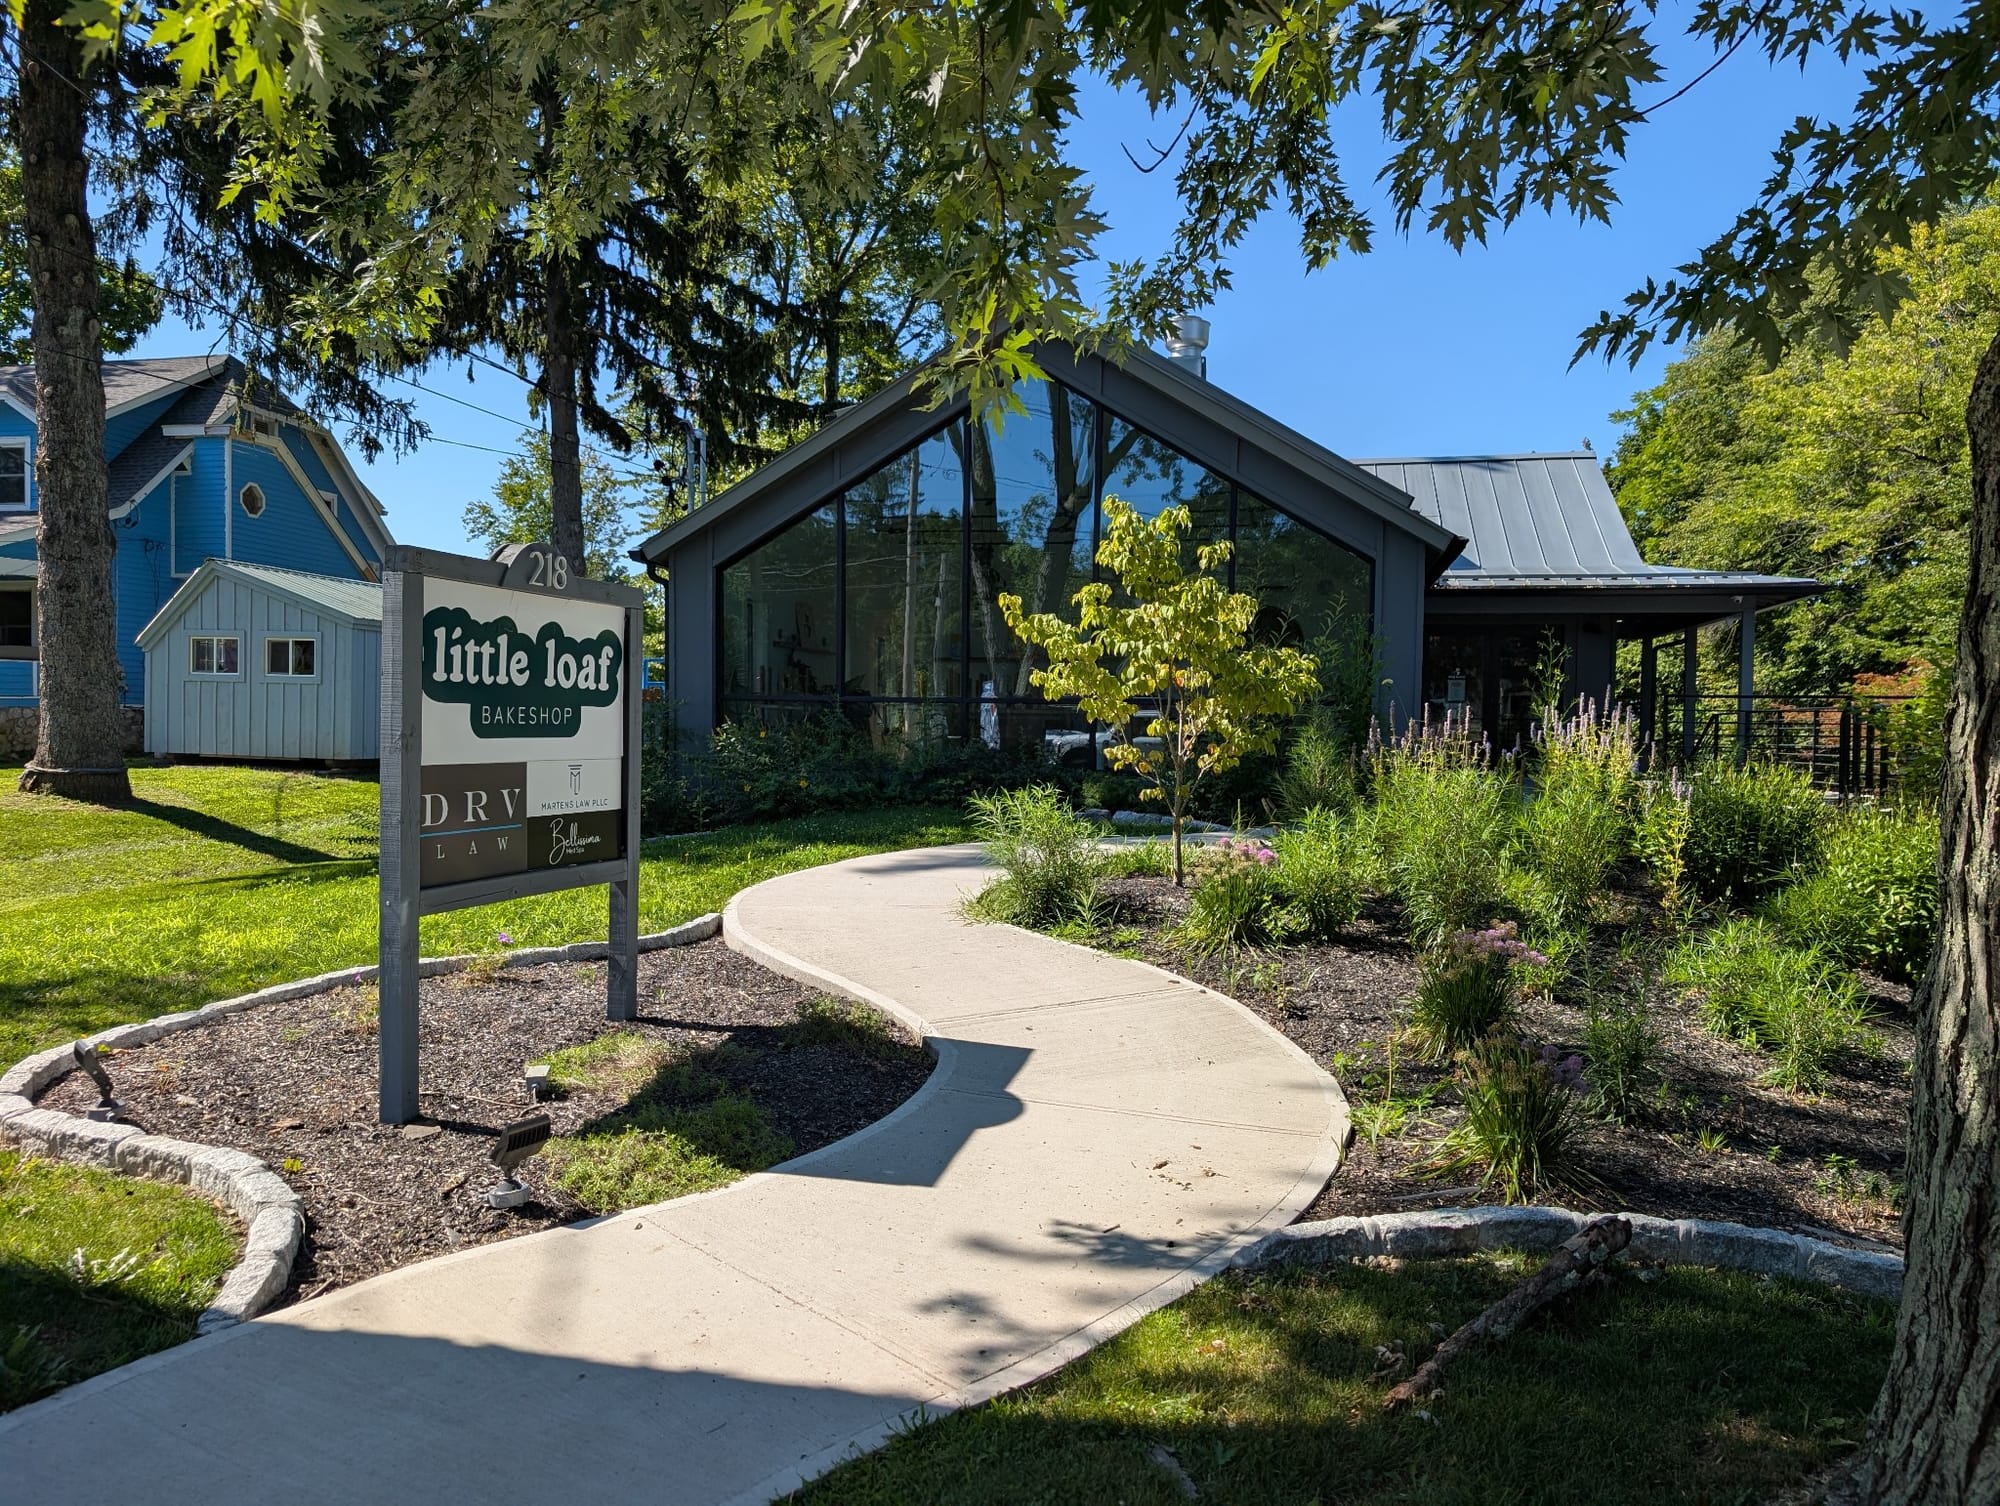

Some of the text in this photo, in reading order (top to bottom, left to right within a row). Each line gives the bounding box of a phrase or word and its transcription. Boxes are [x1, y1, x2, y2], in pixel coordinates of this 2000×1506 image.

[528, 551, 568, 590] 218
[432, 626, 614, 691] little loaf
[481, 705, 573, 725] BAKESHOP
[420, 788, 521, 827] DRV
[541, 798, 609, 811] MARTENS LAW PLLC
[436, 836, 509, 859] LAW
[549, 817, 602, 865] Bellissima
